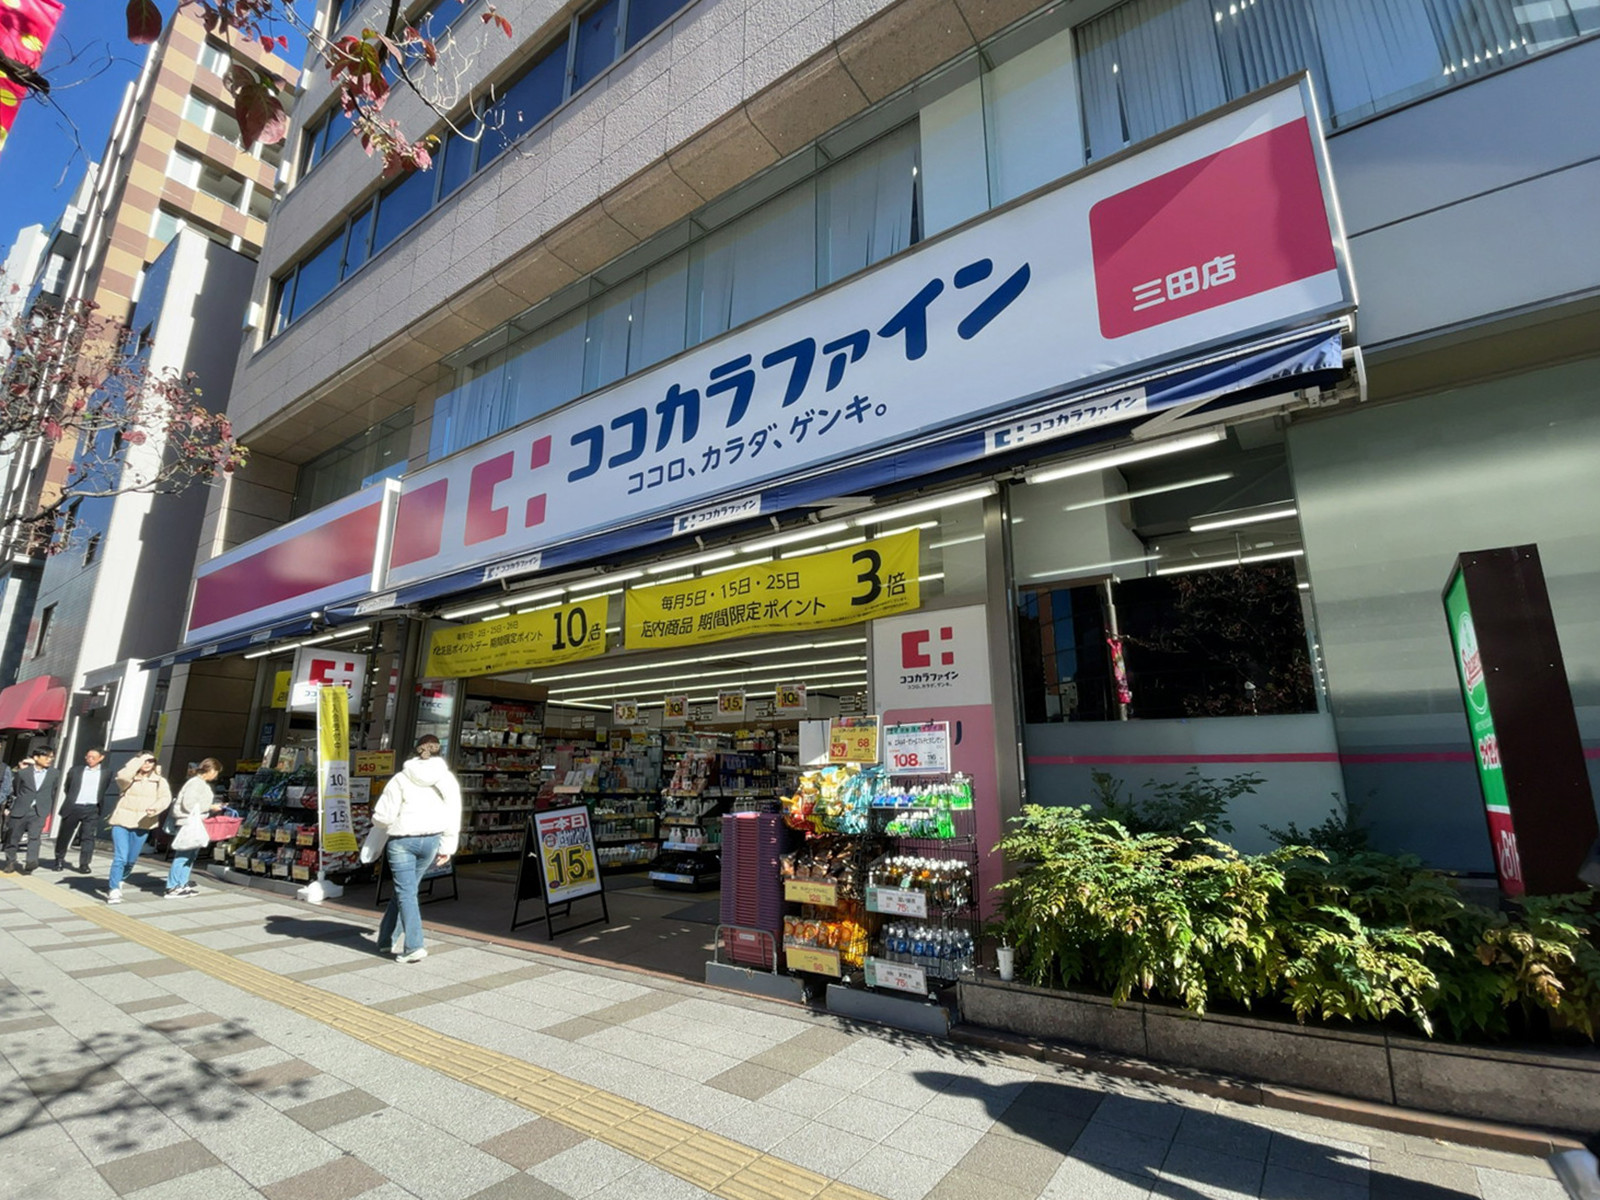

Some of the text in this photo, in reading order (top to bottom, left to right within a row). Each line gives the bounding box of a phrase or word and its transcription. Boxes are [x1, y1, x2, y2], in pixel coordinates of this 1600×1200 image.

[1132, 253, 1236, 312] 三田店
[567, 257, 1032, 484] ココカラファイン
[1030, 396, 1138, 434] ココカラファイン
[698, 500, 757, 522] ココカラファイン
[900, 671, 959, 684] ココカラファイン
[857, 738, 870, 748] 68
[893, 753, 919, 767] 108
